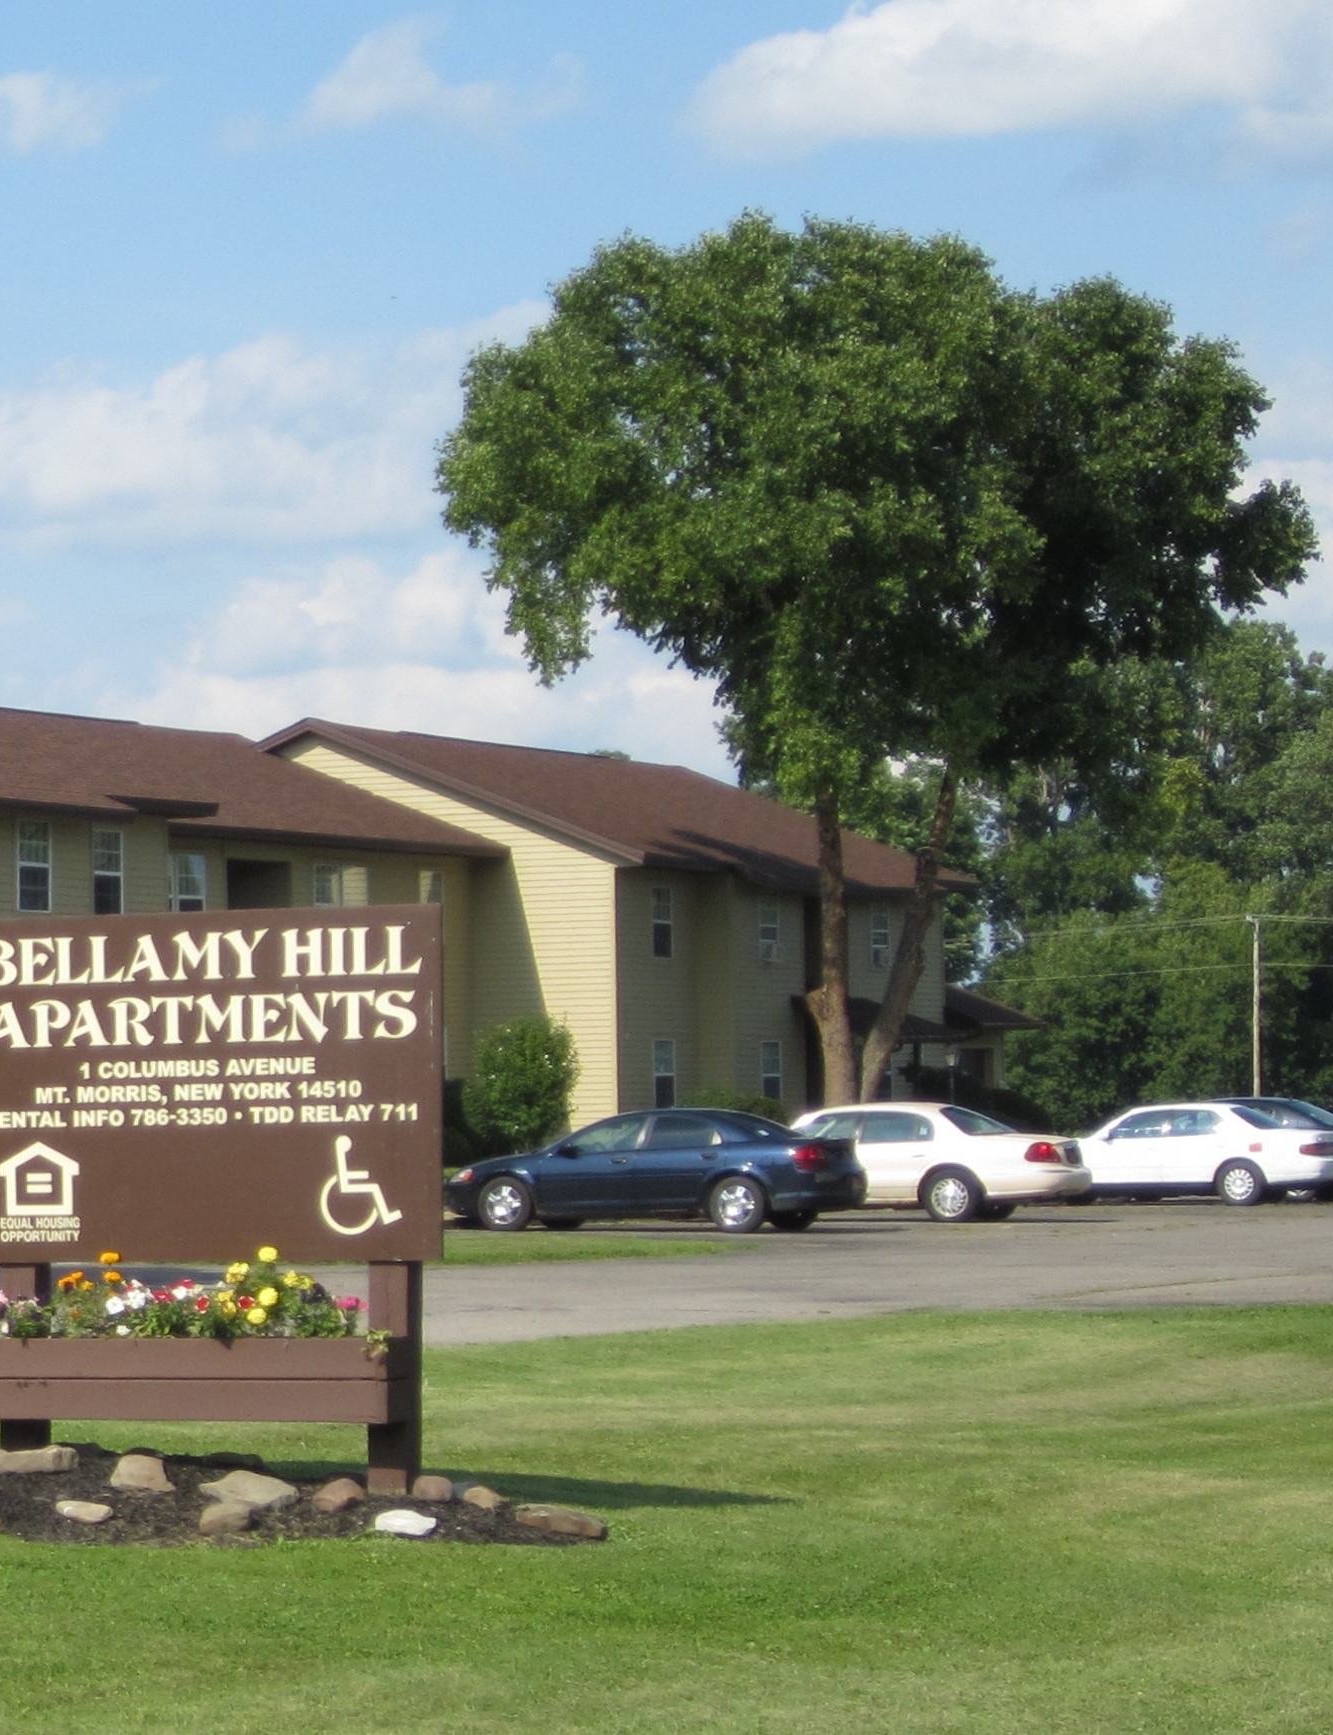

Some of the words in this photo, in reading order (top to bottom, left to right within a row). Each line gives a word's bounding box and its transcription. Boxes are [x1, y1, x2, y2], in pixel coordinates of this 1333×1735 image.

[281, 924, 423, 978] HILL
[79, 1062, 90, 1080] 1
[98, 1059, 220, 1079] COLUMBUS
[225, 1056, 316, 1076] AVENUE
[35, 1087, 71, 1105] MT.
[76, 1084, 168, 1105] MORRIS,
[174, 1083, 224, 1101] NEW
[229, 1081, 292, 1100] YORK
[297, 1079, 363, 1098] 14510
[73, 1108, 125, 1127] INFO
[130, 1106, 228, 1126] 786-3350
[249, 1104, 295, 1124] TDD
[300, 1103, 375, 1123] RELAY
[380, 1102, 419, 1121] 711
[0, 1216, 34, 1229] EQUAL
[36, 1216, 81, 1229] HOUSING
[0, 1229, 81, 1243] OPPORTUNITY
